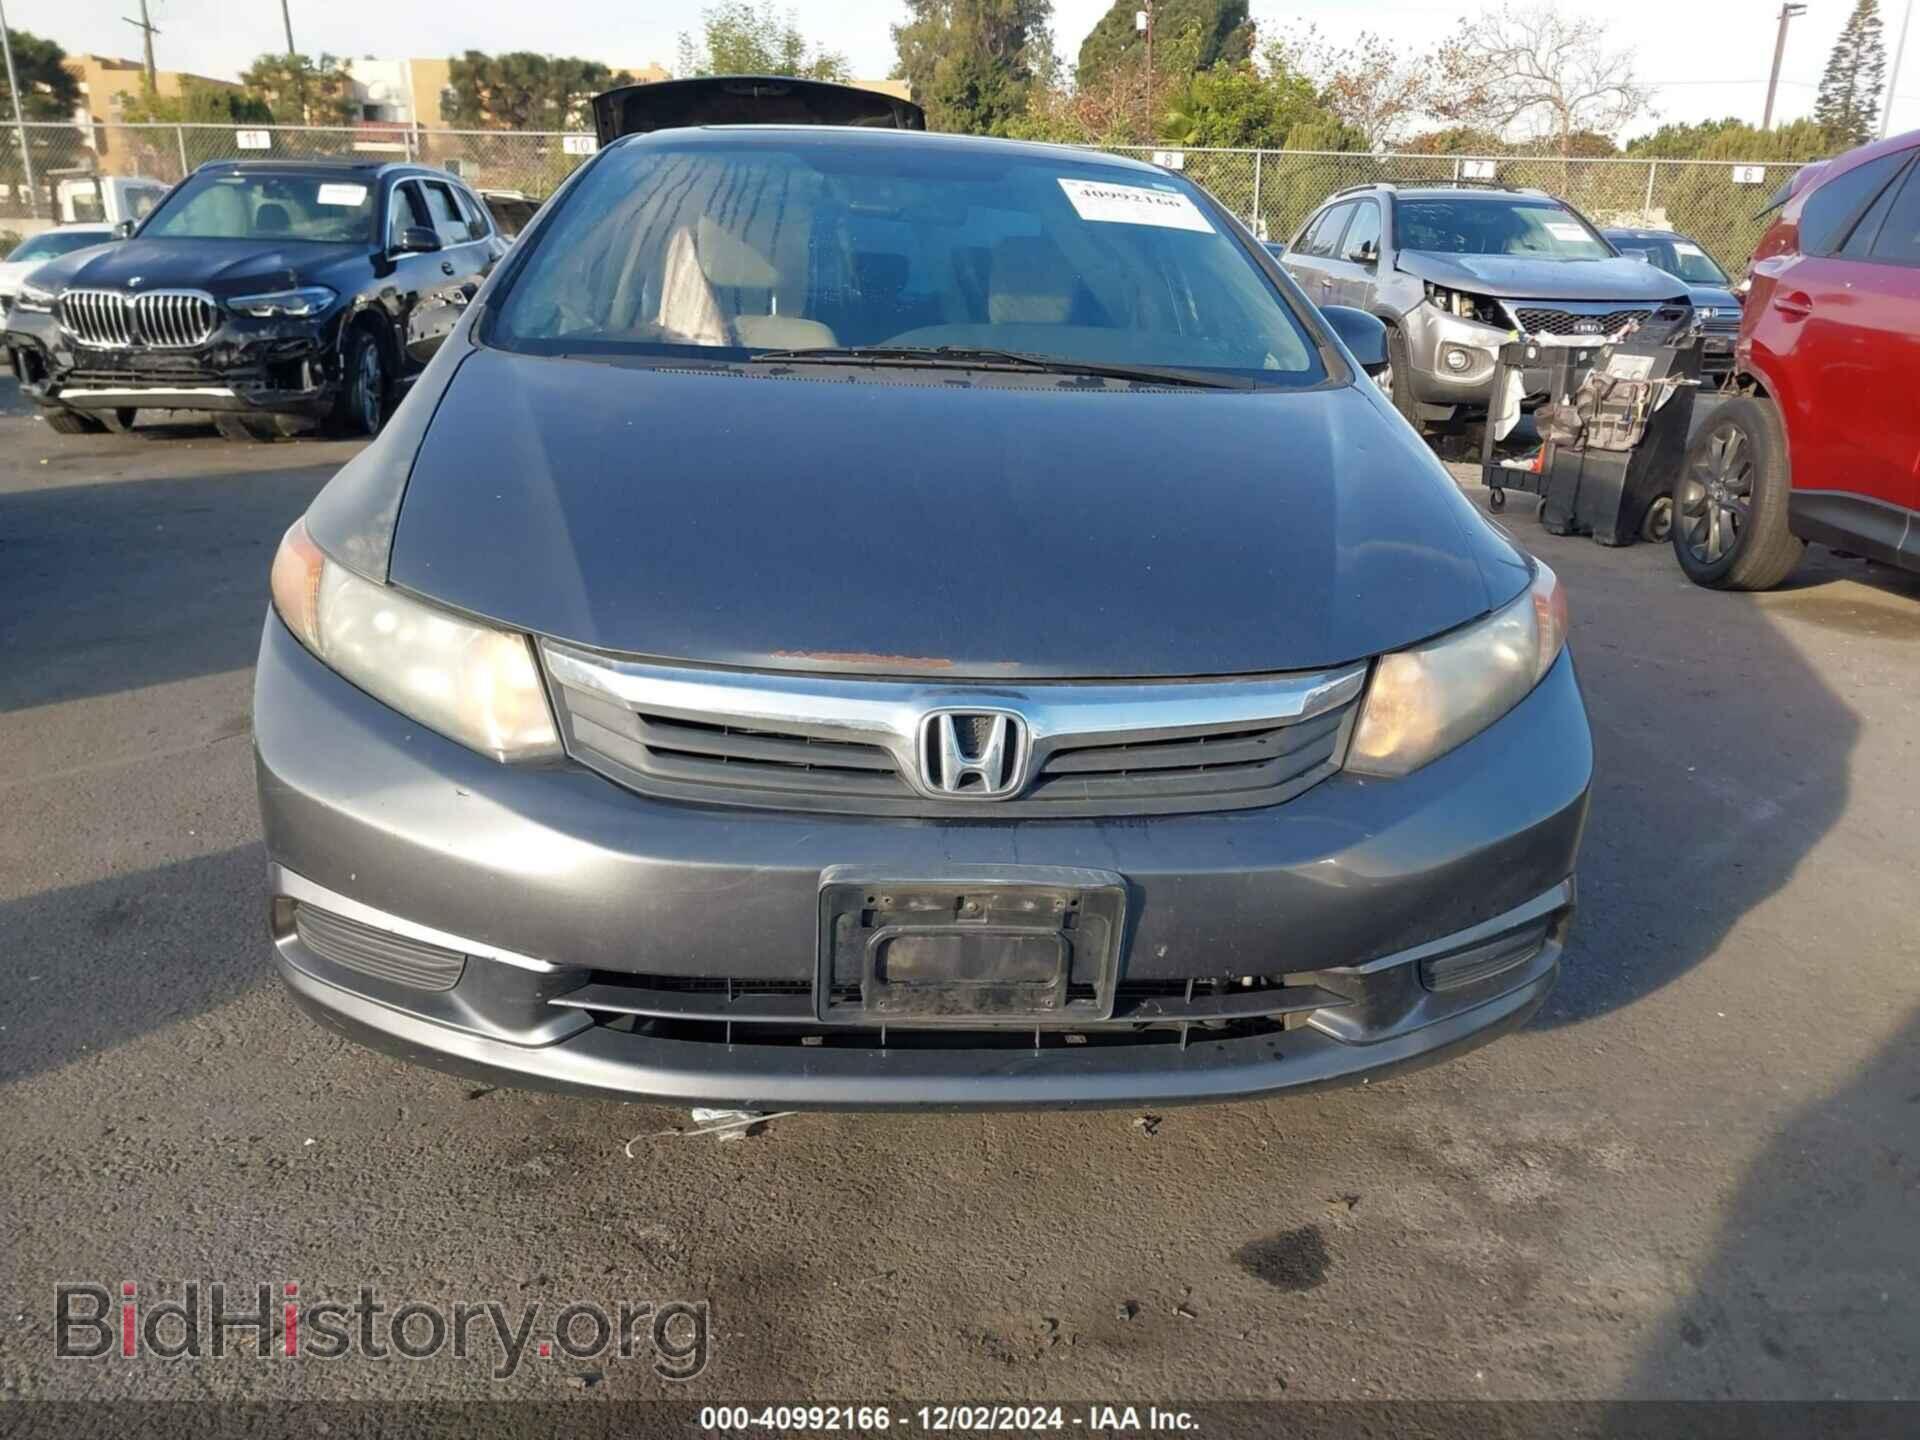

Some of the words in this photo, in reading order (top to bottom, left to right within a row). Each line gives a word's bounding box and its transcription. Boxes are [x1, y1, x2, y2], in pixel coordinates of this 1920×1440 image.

[245, 132, 258, 146] 11
[571, 139, 590, 152] 10
[1163, 153, 1173, 168] 8
[1474, 161, 1485, 176] 7
[1743, 167, 1753, 181] 6
